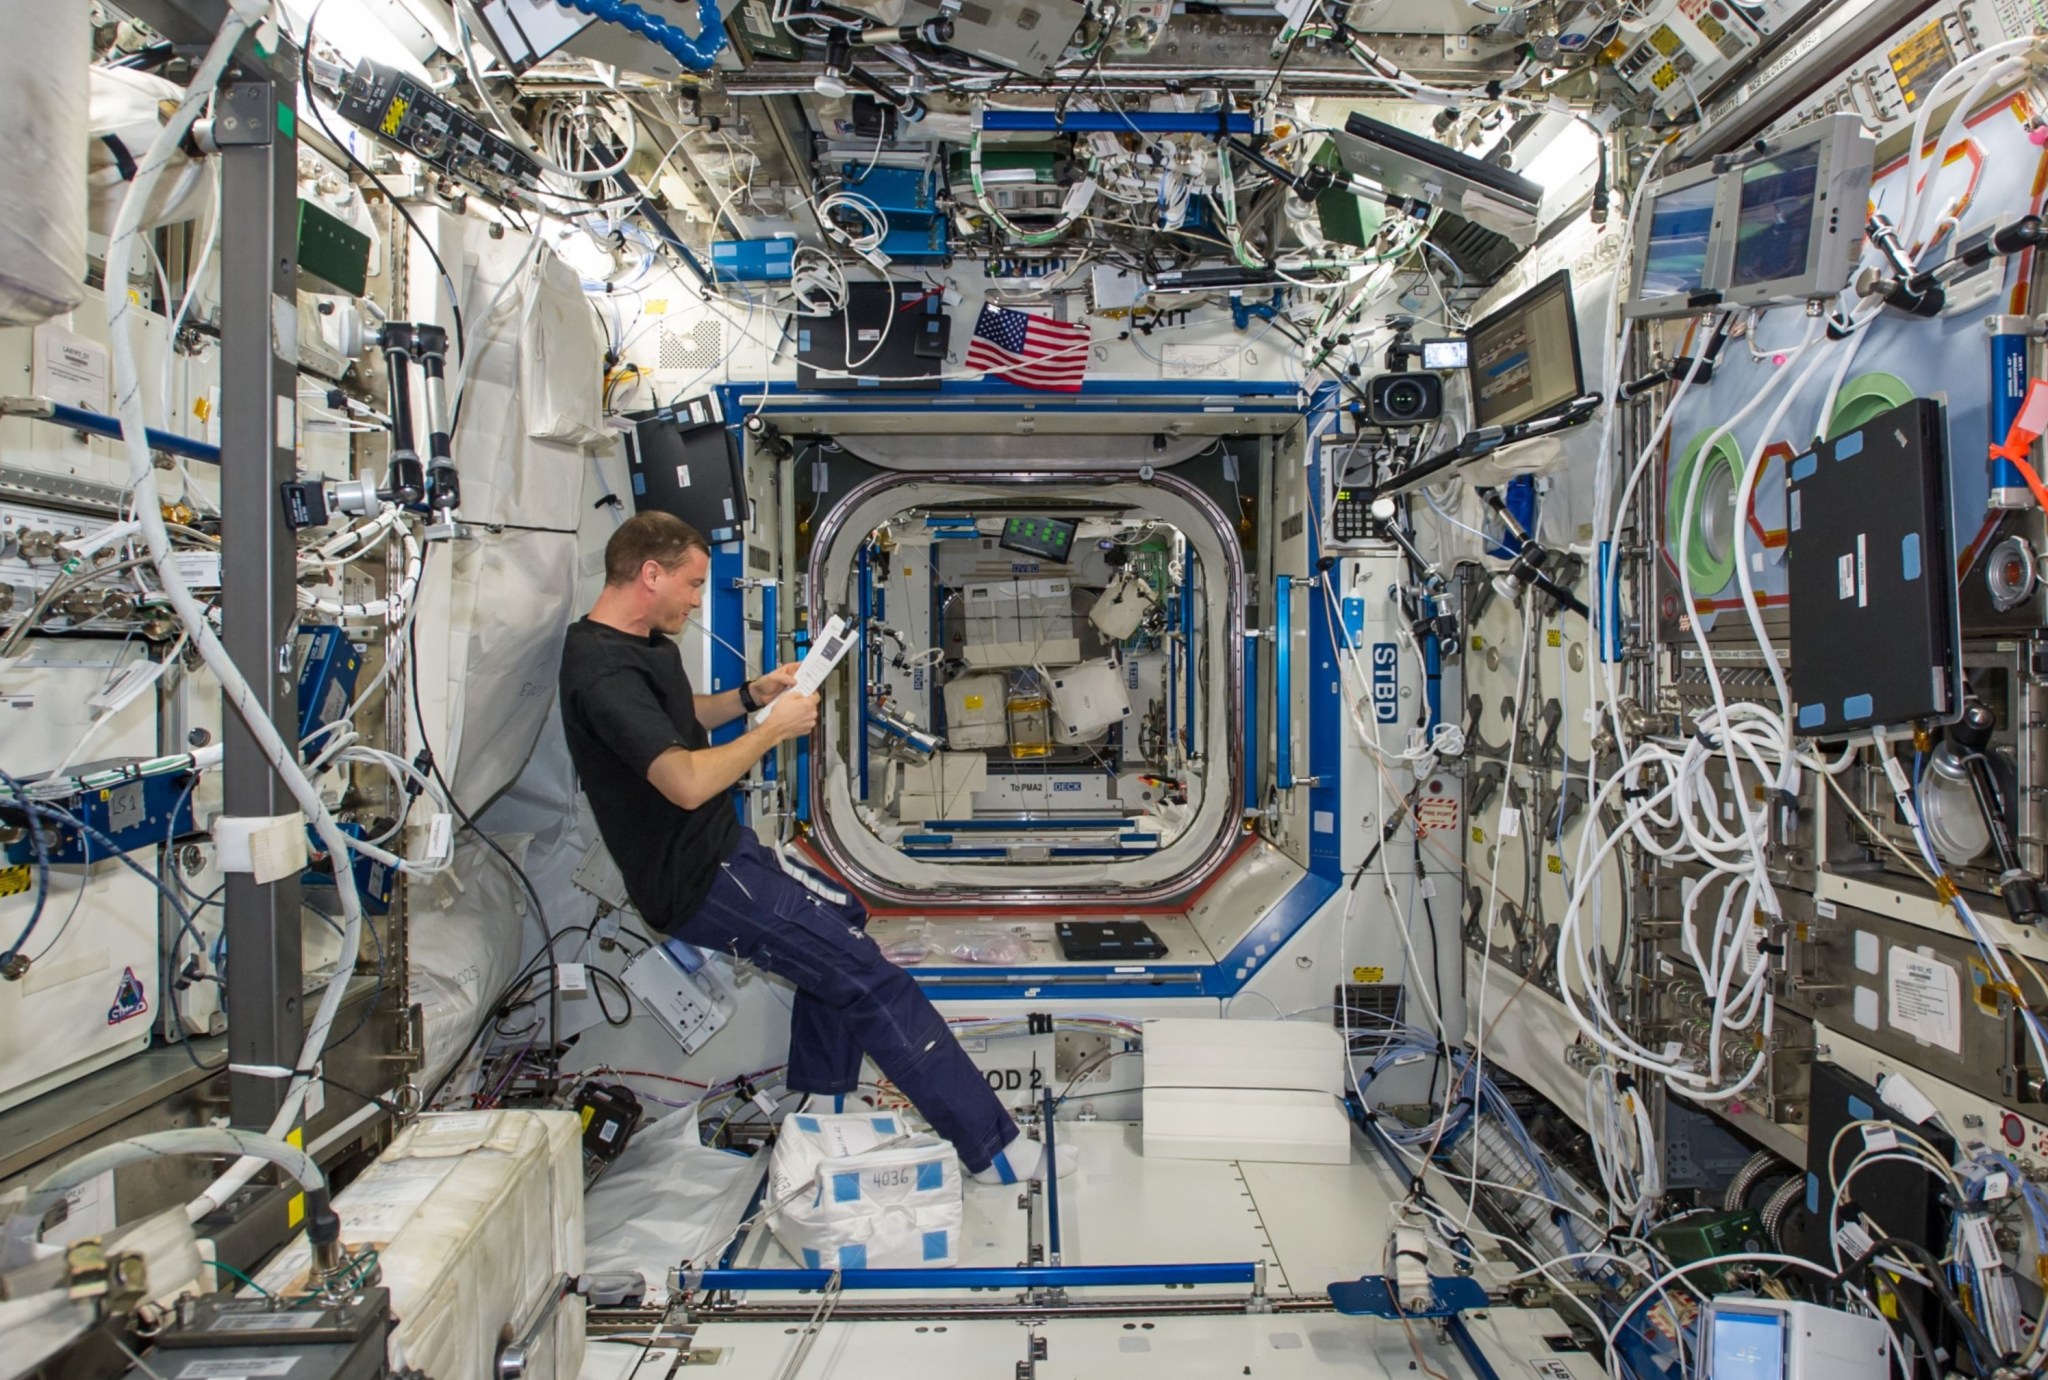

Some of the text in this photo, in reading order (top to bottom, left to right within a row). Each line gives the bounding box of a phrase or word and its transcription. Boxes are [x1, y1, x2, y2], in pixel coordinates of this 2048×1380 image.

[1762, 47, 1798, 84] GLOVEBOX
[1132, 309, 1191, 329] EXIT
[1377, 646, 1396, 722] STBD
[1010, 783, 1043, 792] To PMA2
[1055, 782, 1081, 791] DECK
[984, 1069, 1043, 1090] OD 2
[872, 1168, 910, 1187] 4036
[1547, 1362, 1570, 1379] LAB
